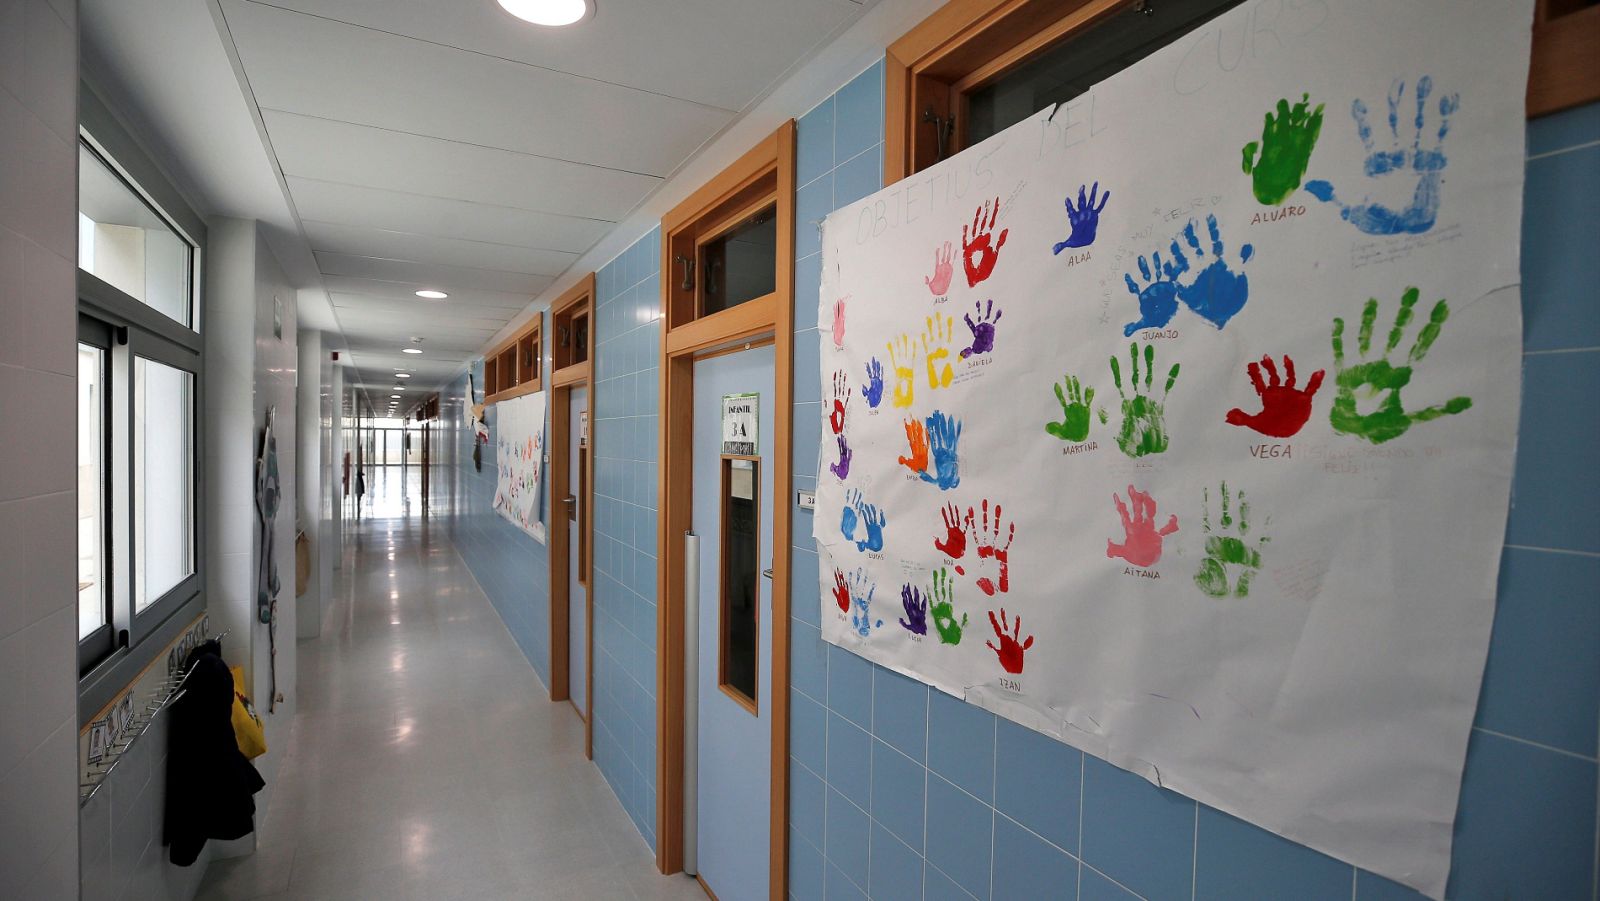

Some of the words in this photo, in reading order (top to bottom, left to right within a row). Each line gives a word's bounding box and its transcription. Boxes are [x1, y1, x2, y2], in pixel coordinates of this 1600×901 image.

[1037, 95, 1108, 162] DEL
[1250, 205, 1307, 226] ALVARO
[1067, 252, 1092, 268] ALAA
[1141, 329, 1179, 341] JUANJO
[728, 404, 752, 414] INFANTIL
[1250, 444, 1292, 460] VEGA
[868, 553, 885, 561] LUCAS
[999, 677, 1021, 692] IZAN
